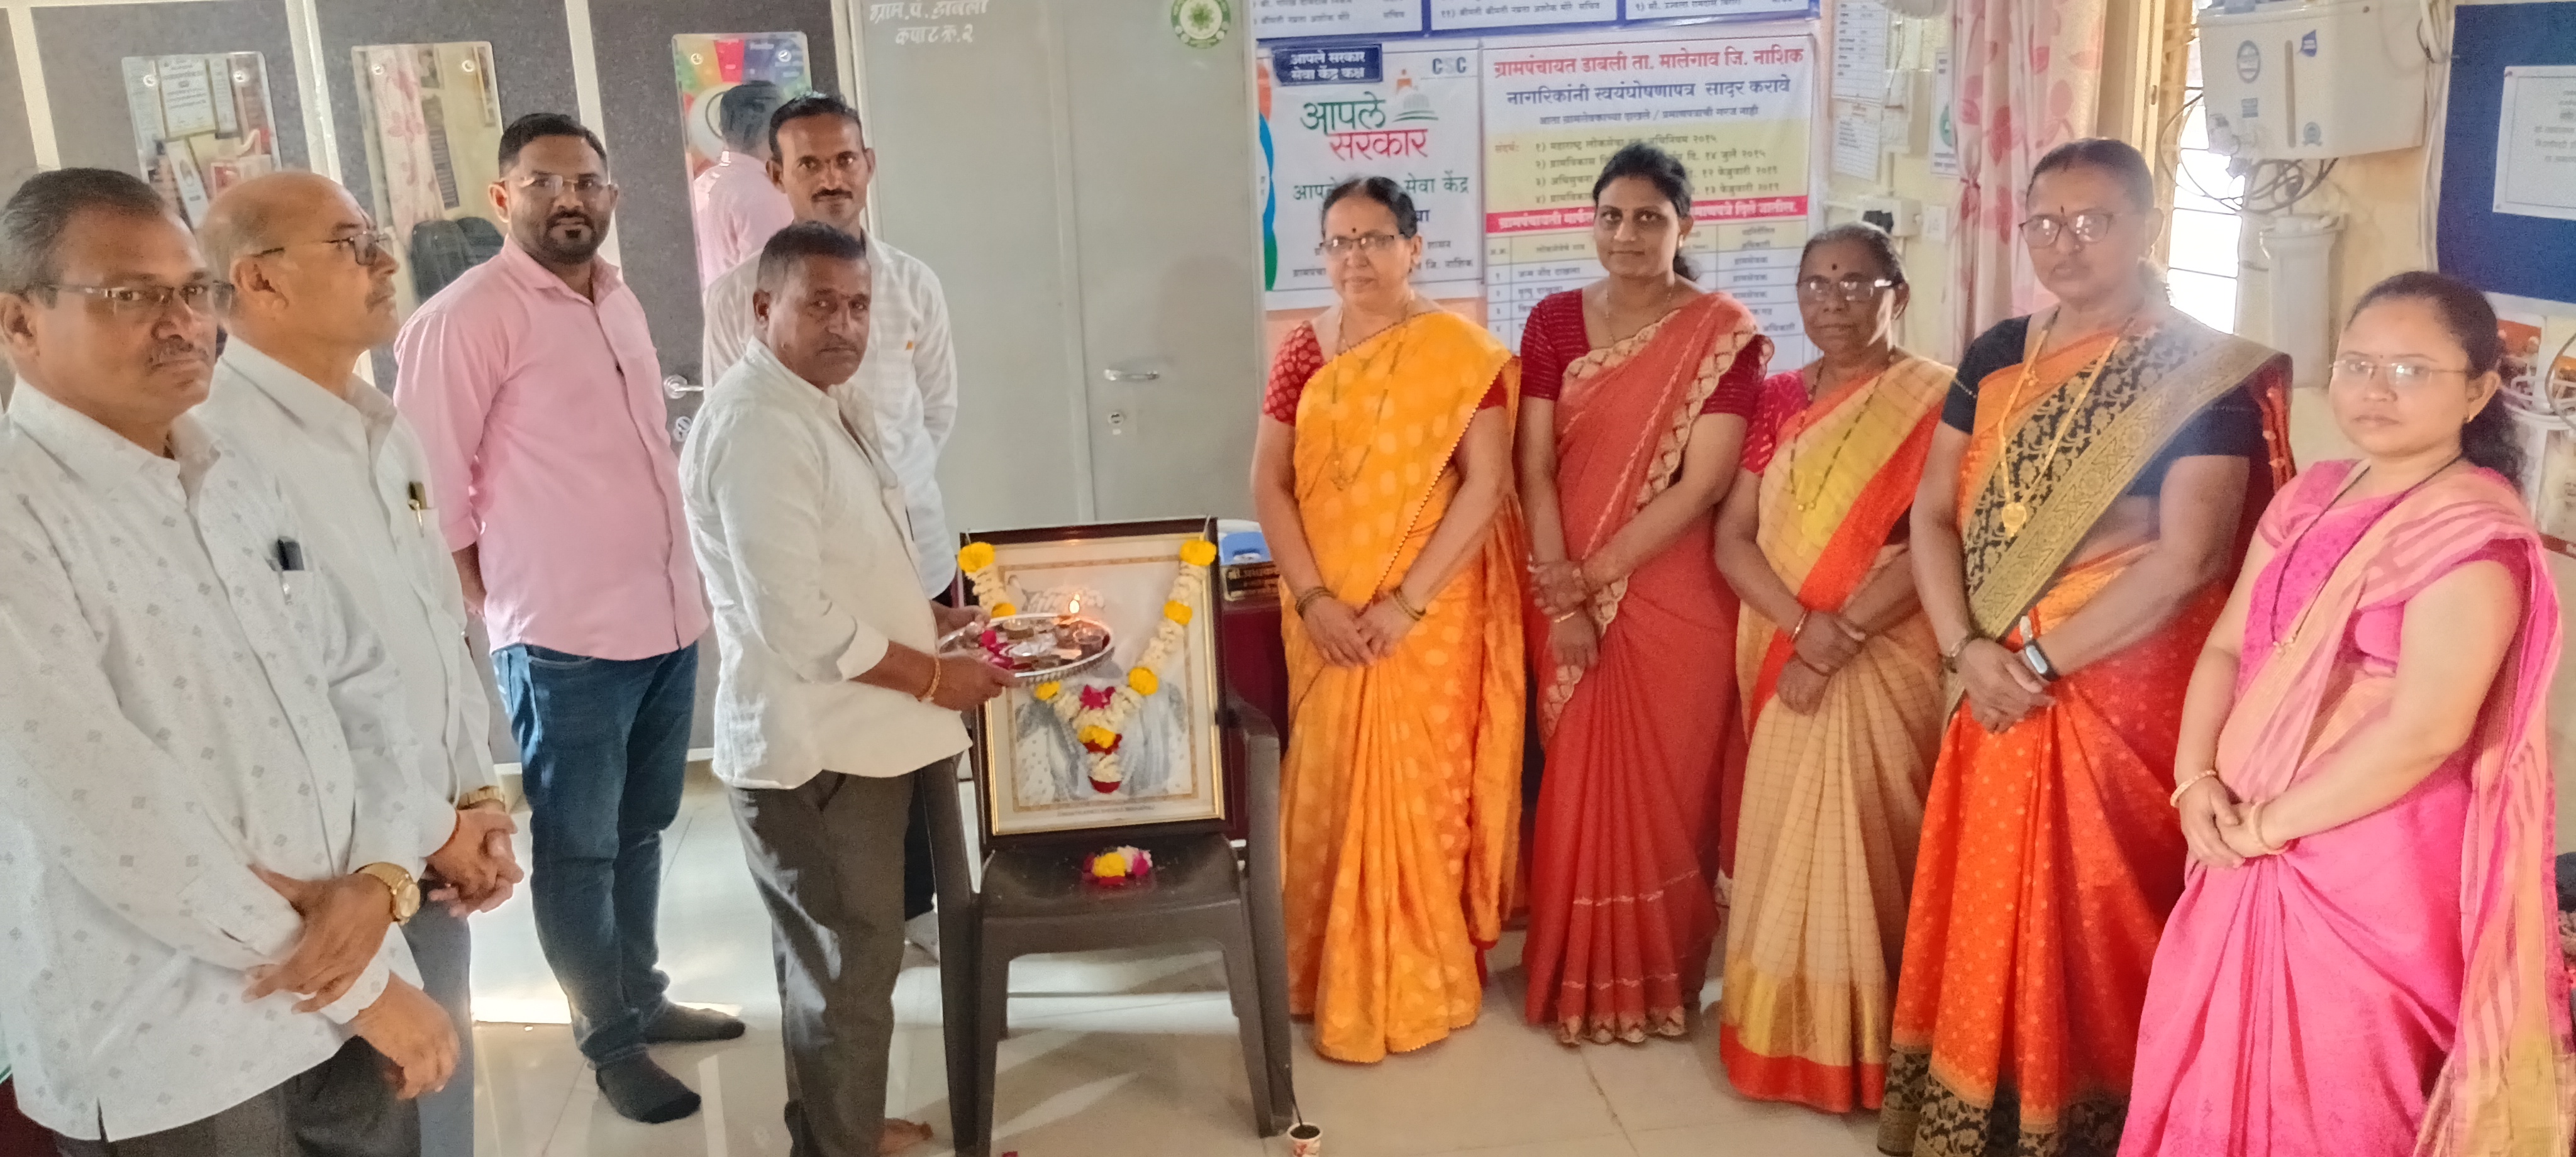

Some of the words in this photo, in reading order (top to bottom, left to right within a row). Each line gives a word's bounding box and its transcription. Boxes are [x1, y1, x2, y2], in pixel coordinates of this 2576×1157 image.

[1290, 49, 1326, 65] आपले
[1328, 52, 1365, 63] सरकार
[1431, 57, 1467, 74] CSC
[1494, 54, 1577, 79] ग्रामपंचायत
[1631, 55, 1654, 70] ता.
[1659, 47, 1720, 69] मालेगाव
[1724, 46, 1748, 65] जि.
[1753, 43, 1804, 65] नाशिक
[1506, 84, 1590, 105] नागरिकांनी
[1594, 80, 1696, 101] स्वयंघोषणापत्र
[1705, 81, 1745, 98] सादर
[1749, 74, 1791, 94] करावे
[1300, 91, 1386, 136] आपले
[1327, 128, 1428, 161] सरकार
[1405, 172, 1435, 194] सेवा
[1443, 170, 1469, 194] केंद्र
